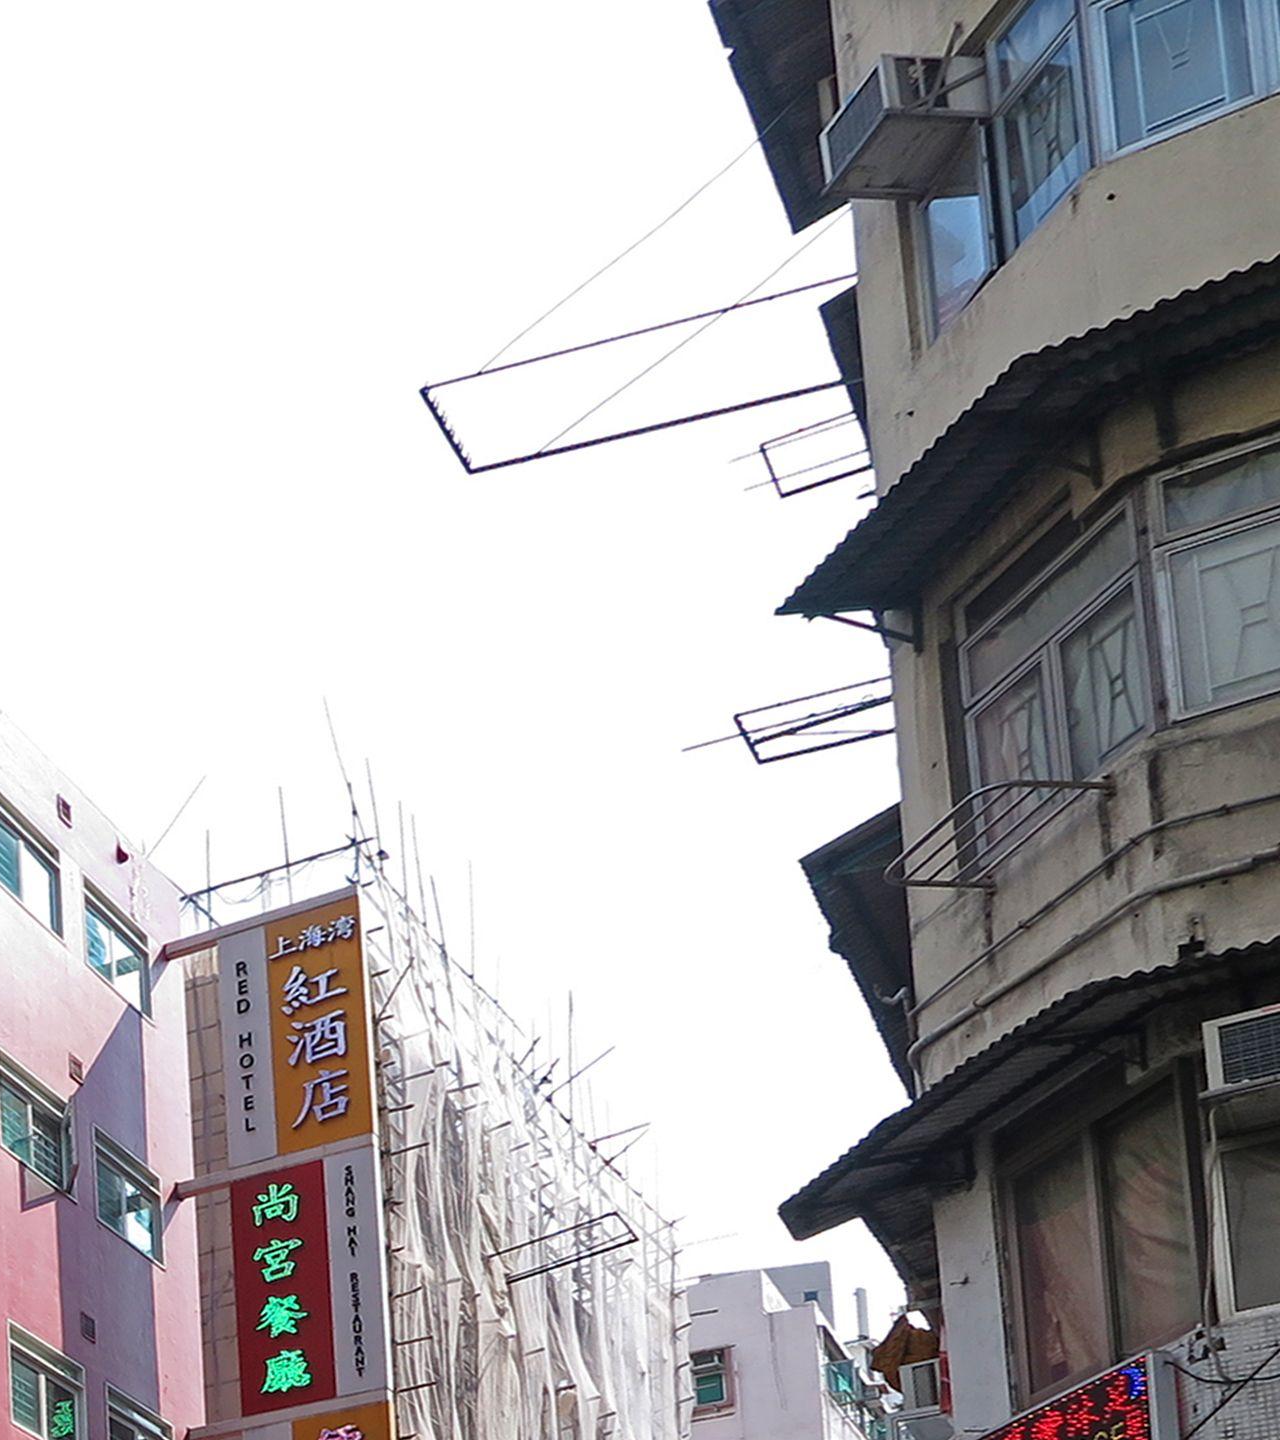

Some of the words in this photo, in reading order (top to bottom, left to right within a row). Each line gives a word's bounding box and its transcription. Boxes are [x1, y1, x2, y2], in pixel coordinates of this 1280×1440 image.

[235, 961, 251, 1015] RED
[239, 1032, 257, 1134] HOTEL
[280, 965, 349, 1130] 紅酒店
[343, 1165, 356, 1218] SHANG
[346, 1225, 358, 1258] HAI
[251, 1183, 313, 1395] 尚宮餐廳
[349, 1272, 366, 1378] RESTAURANT
